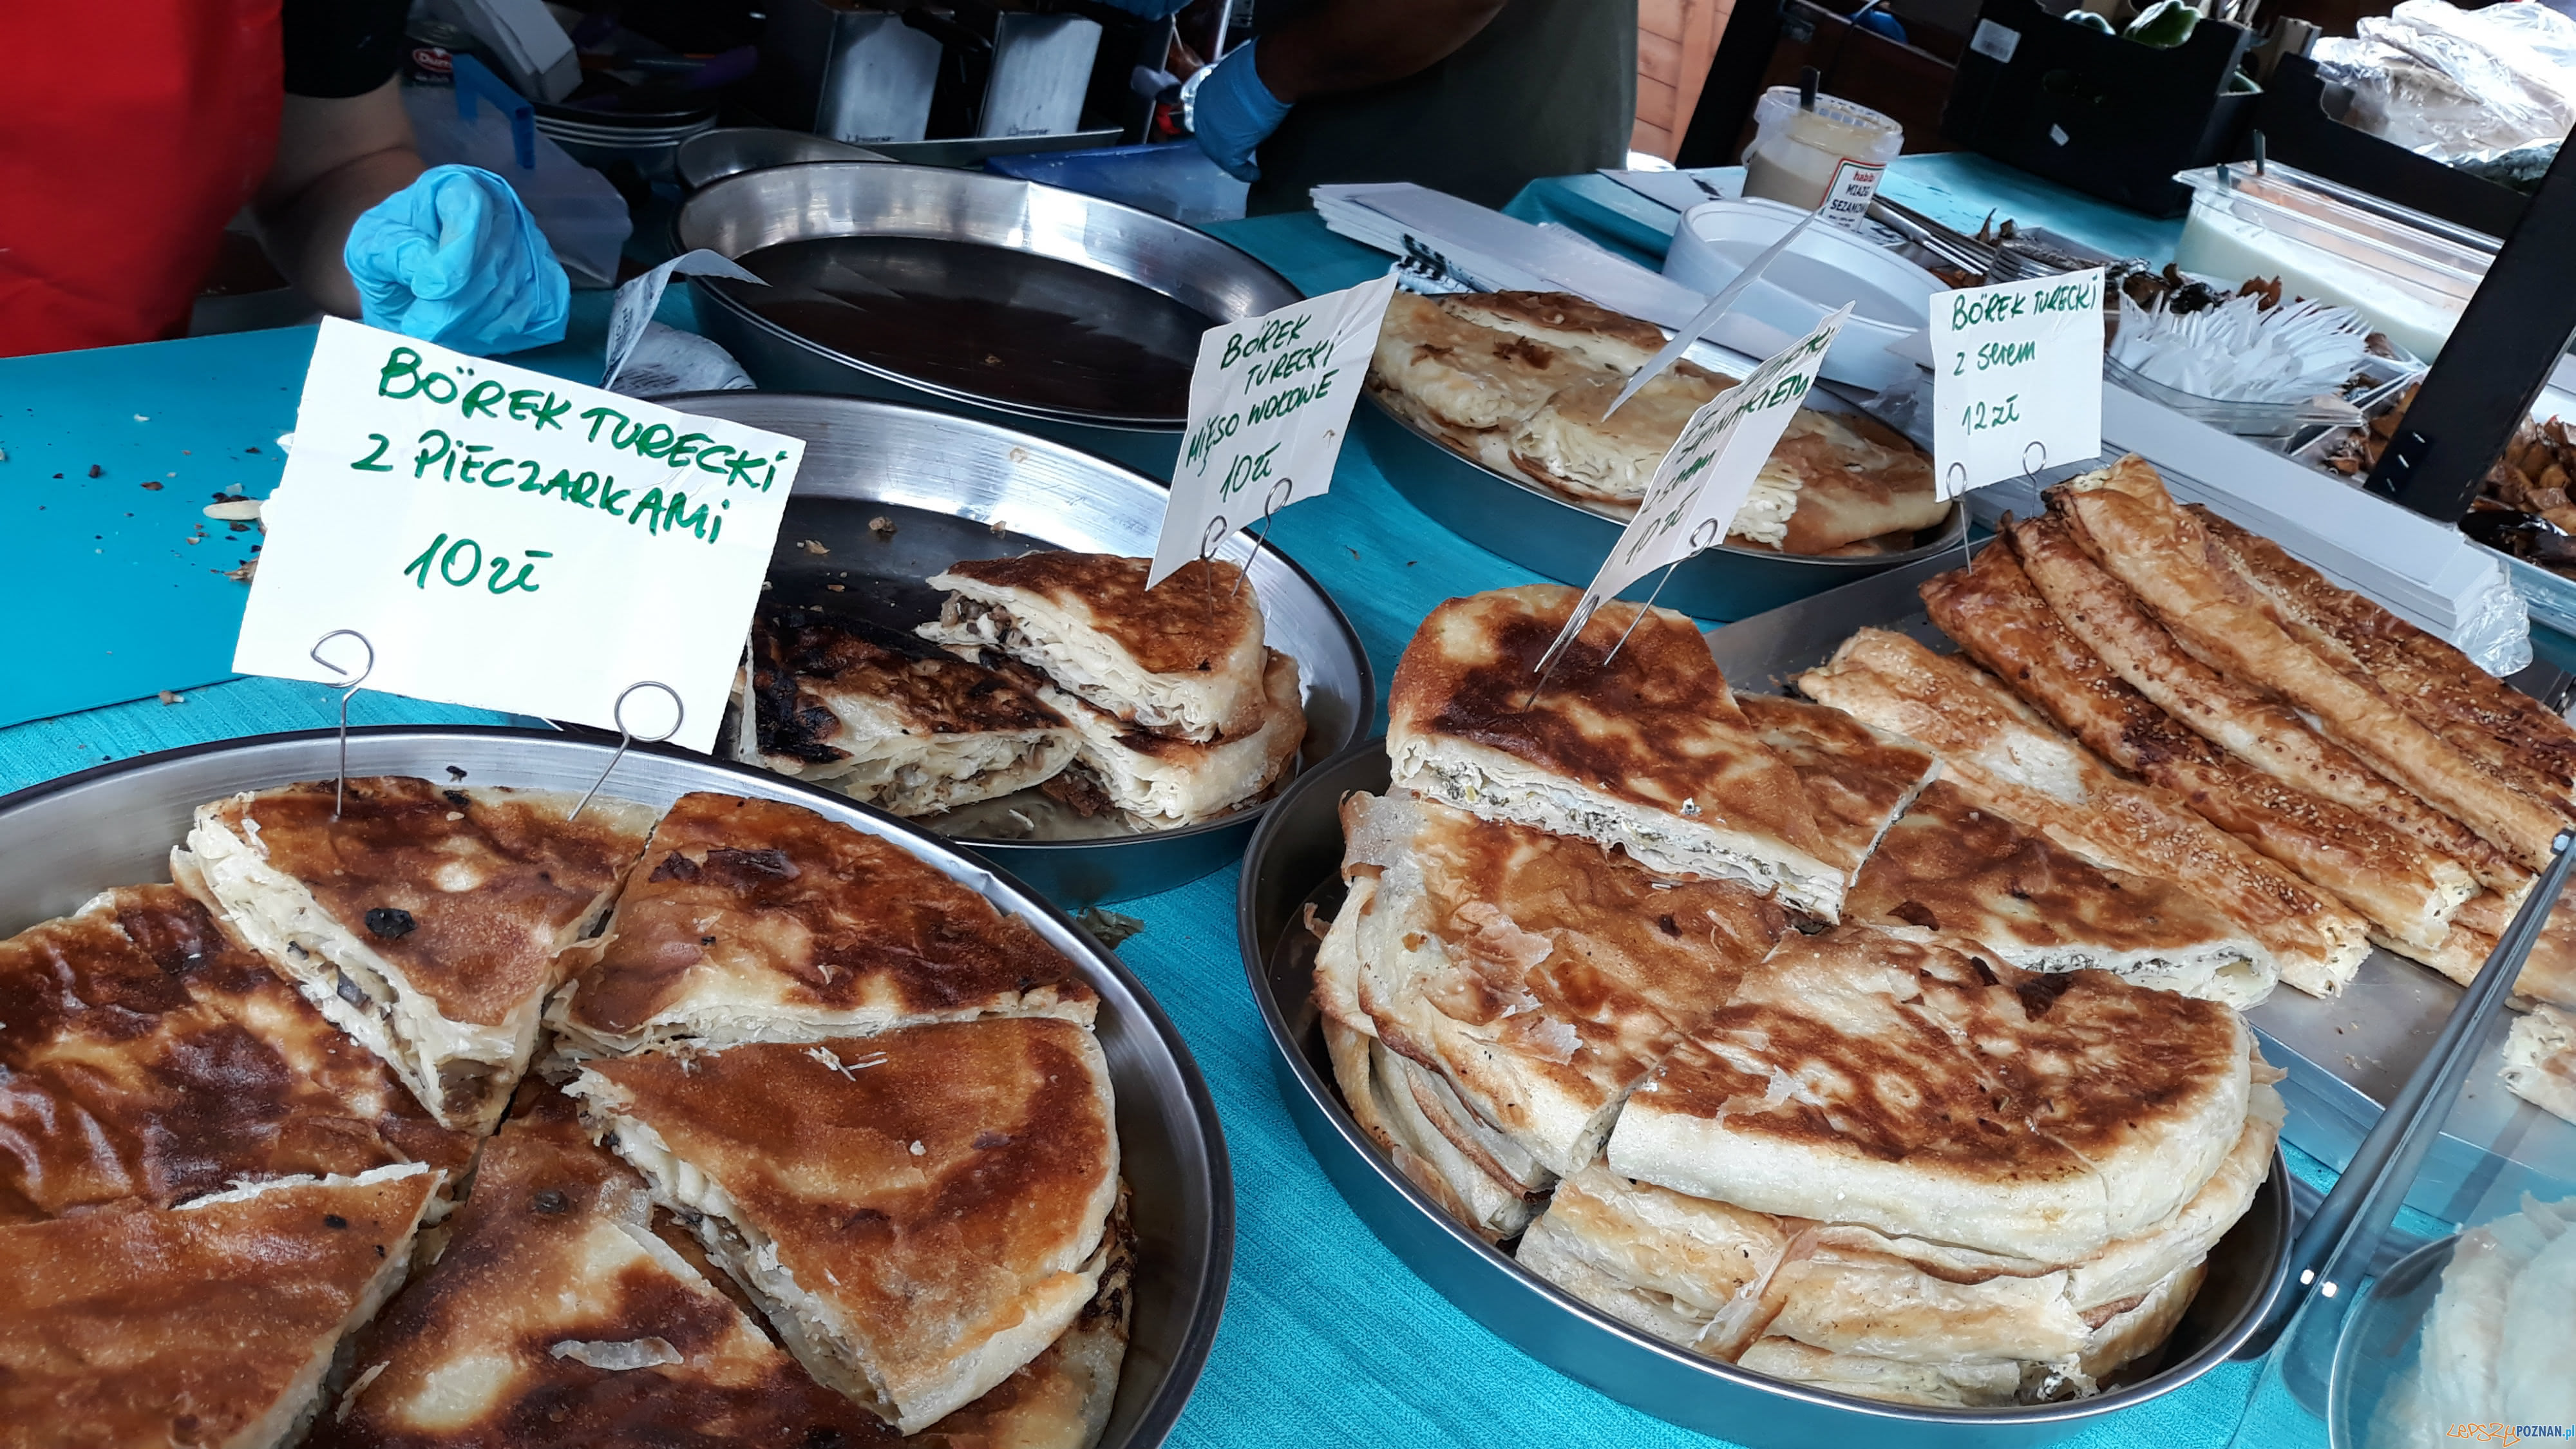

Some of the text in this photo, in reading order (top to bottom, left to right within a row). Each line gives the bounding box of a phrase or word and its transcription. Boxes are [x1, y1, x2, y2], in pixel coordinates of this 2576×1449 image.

[1952, 274, 2098, 331] BÖREK TURECKI
[1220, 314, 1312, 370] BÖREK
[1244, 330, 1341, 395] TURECKI
[1977, 340, 2035, 371] serem
[378, 346, 790, 493] BÖREK TURECKI
[413, 429, 731, 545] PIECZARKAMI
